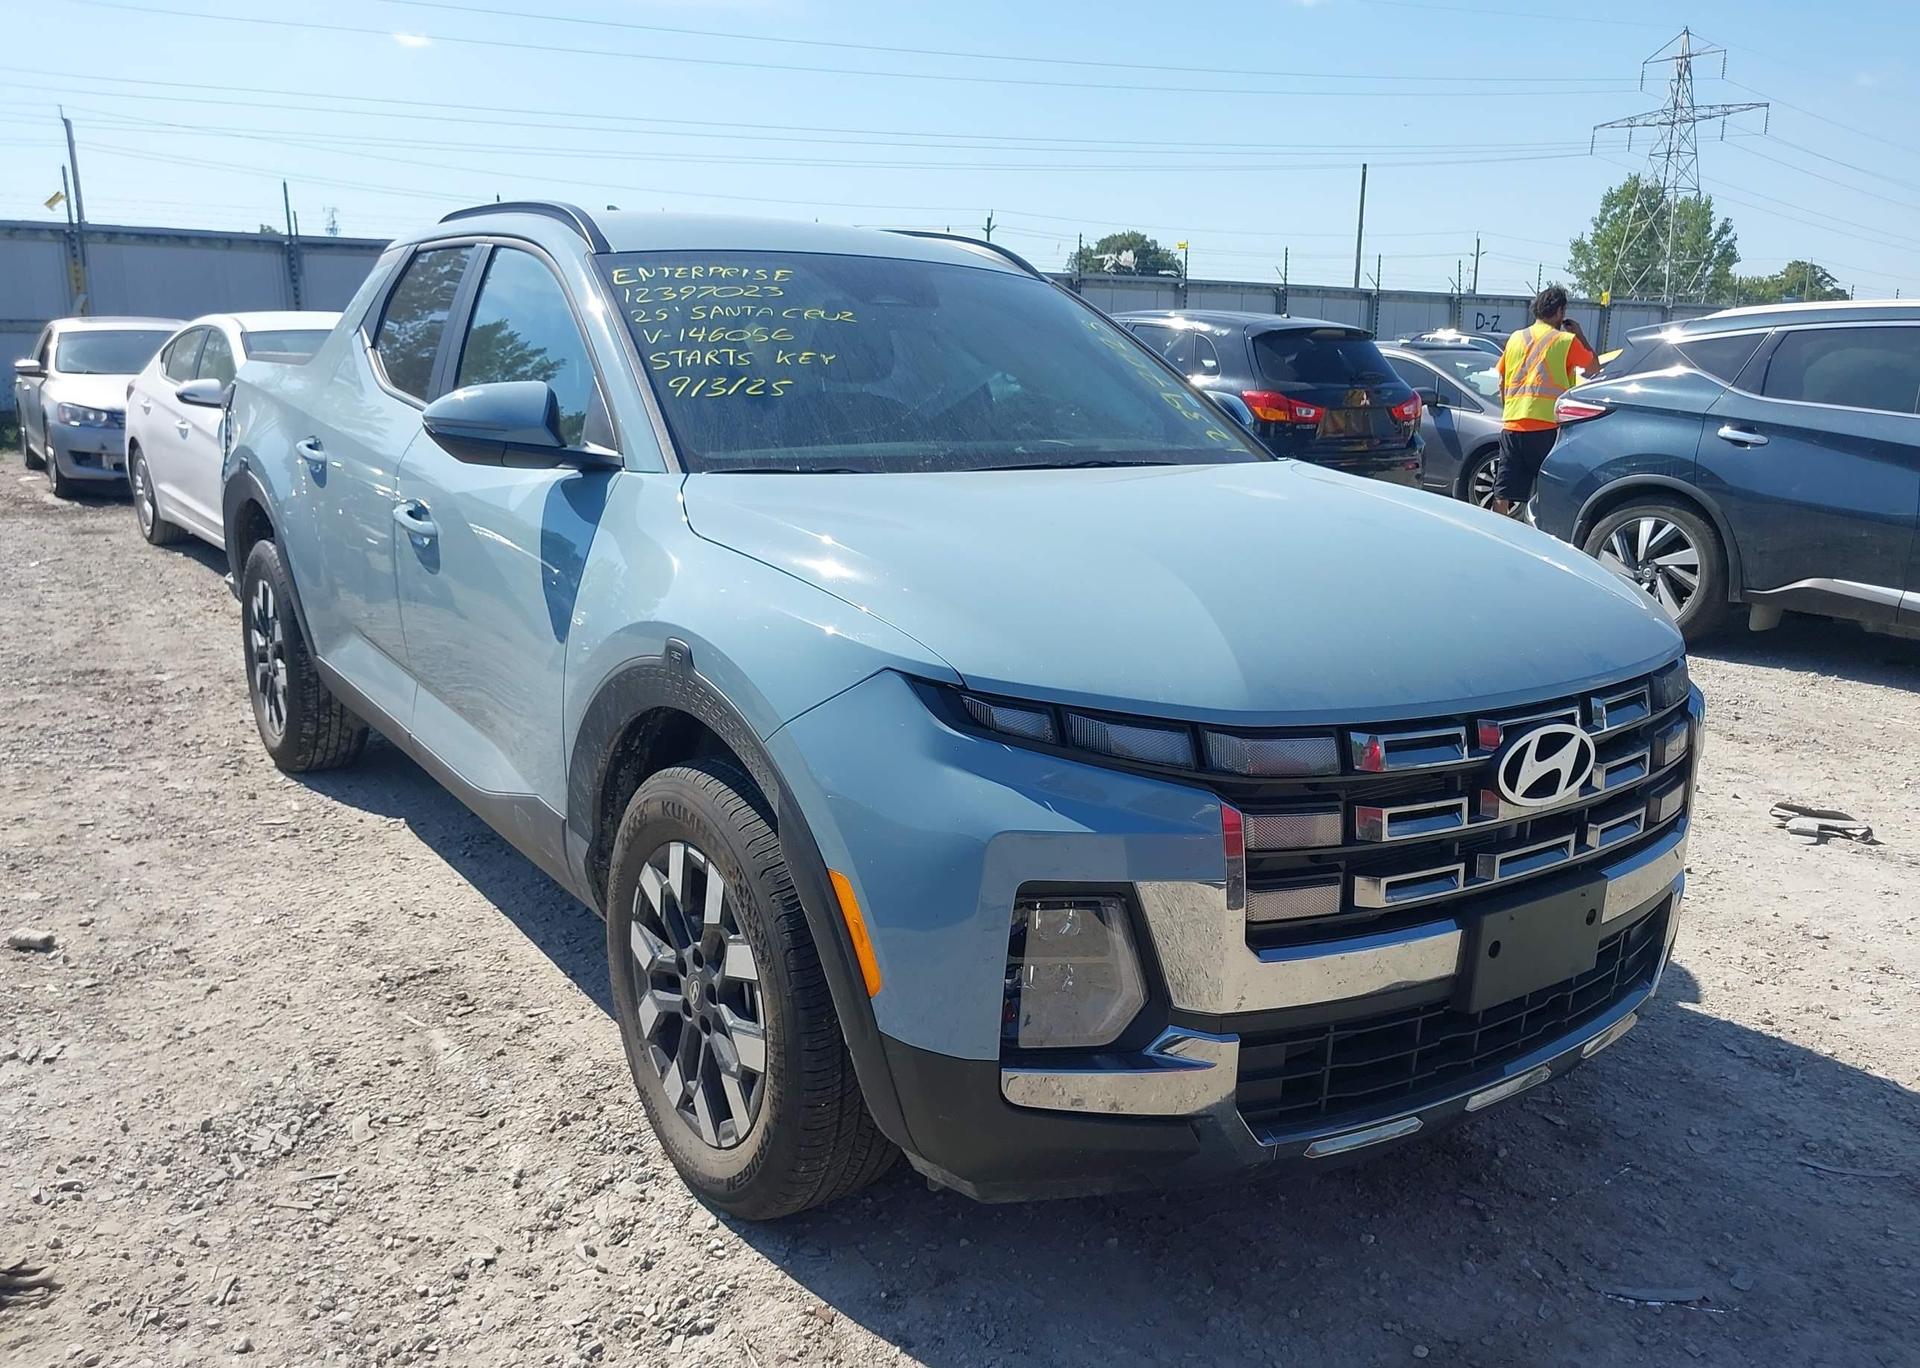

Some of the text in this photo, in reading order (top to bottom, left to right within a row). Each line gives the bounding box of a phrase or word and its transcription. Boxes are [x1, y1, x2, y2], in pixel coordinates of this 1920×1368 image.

[612, 266, 793, 284] ENTERPRISE
[624, 285, 784, 303] 12397023
[690, 305, 773, 319] SANTA
[782, 307, 857, 322] CRUZ
[650, 349, 836, 370] STARTS KEY
[668, 376, 793, 397] 9/3/25
